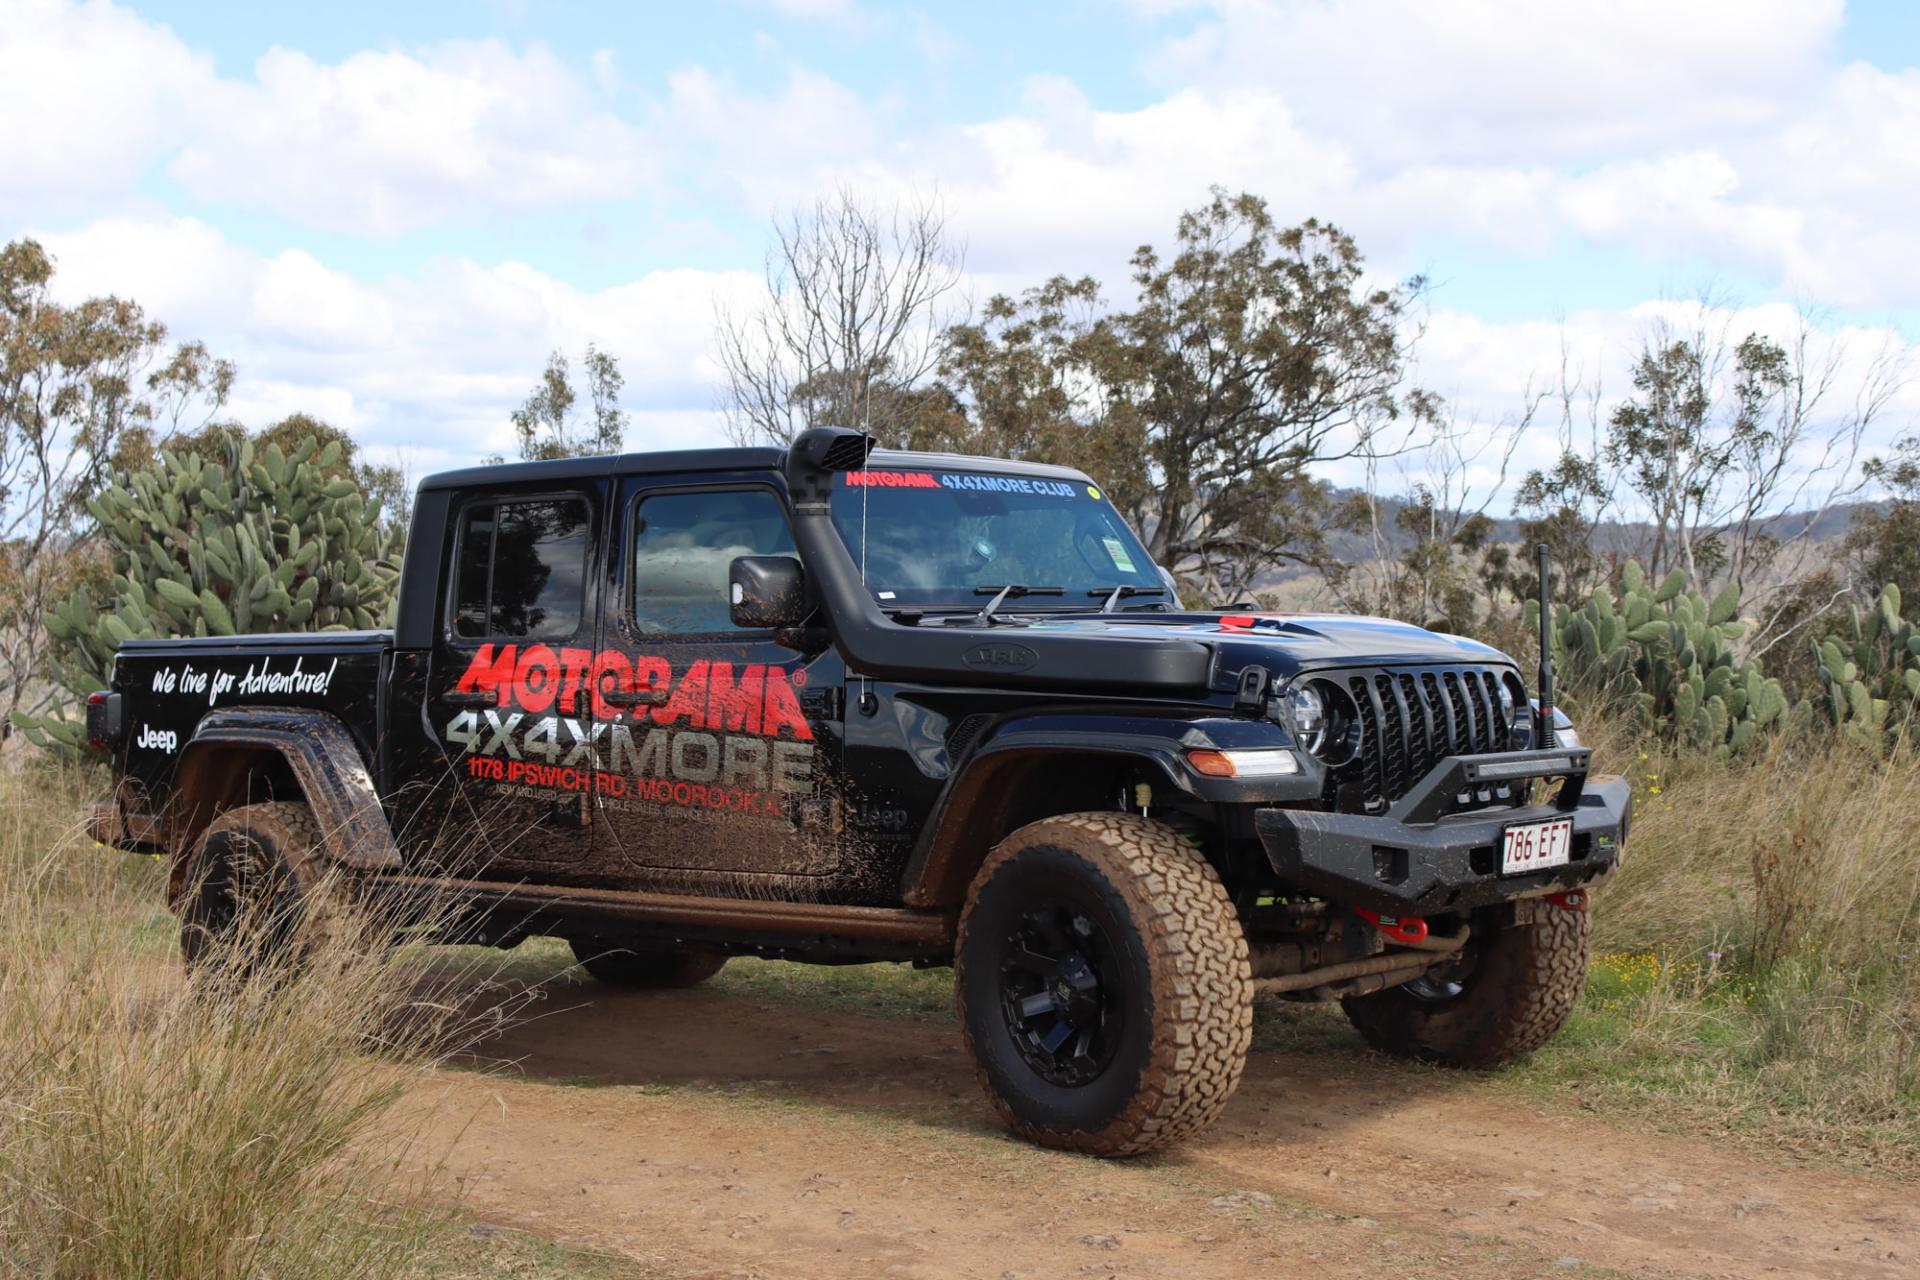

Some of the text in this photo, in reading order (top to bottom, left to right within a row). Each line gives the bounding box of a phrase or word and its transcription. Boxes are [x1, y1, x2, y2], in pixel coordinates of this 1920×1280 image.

[942, 475, 1034, 494] 4X4XMORE
[1034, 481, 1076, 497] CLUB
[152, 656, 338, 706] We live for Adventure!
[455, 643, 815, 741] MOTORAMA
[137, 724, 177, 754] Jeep
[446, 709, 815, 794] 4X4XMORE
[469, 756, 504, 781] 1178
[508, 762, 588, 792] IPSWICH
[1504, 823, 1569, 863] 786 EF7
